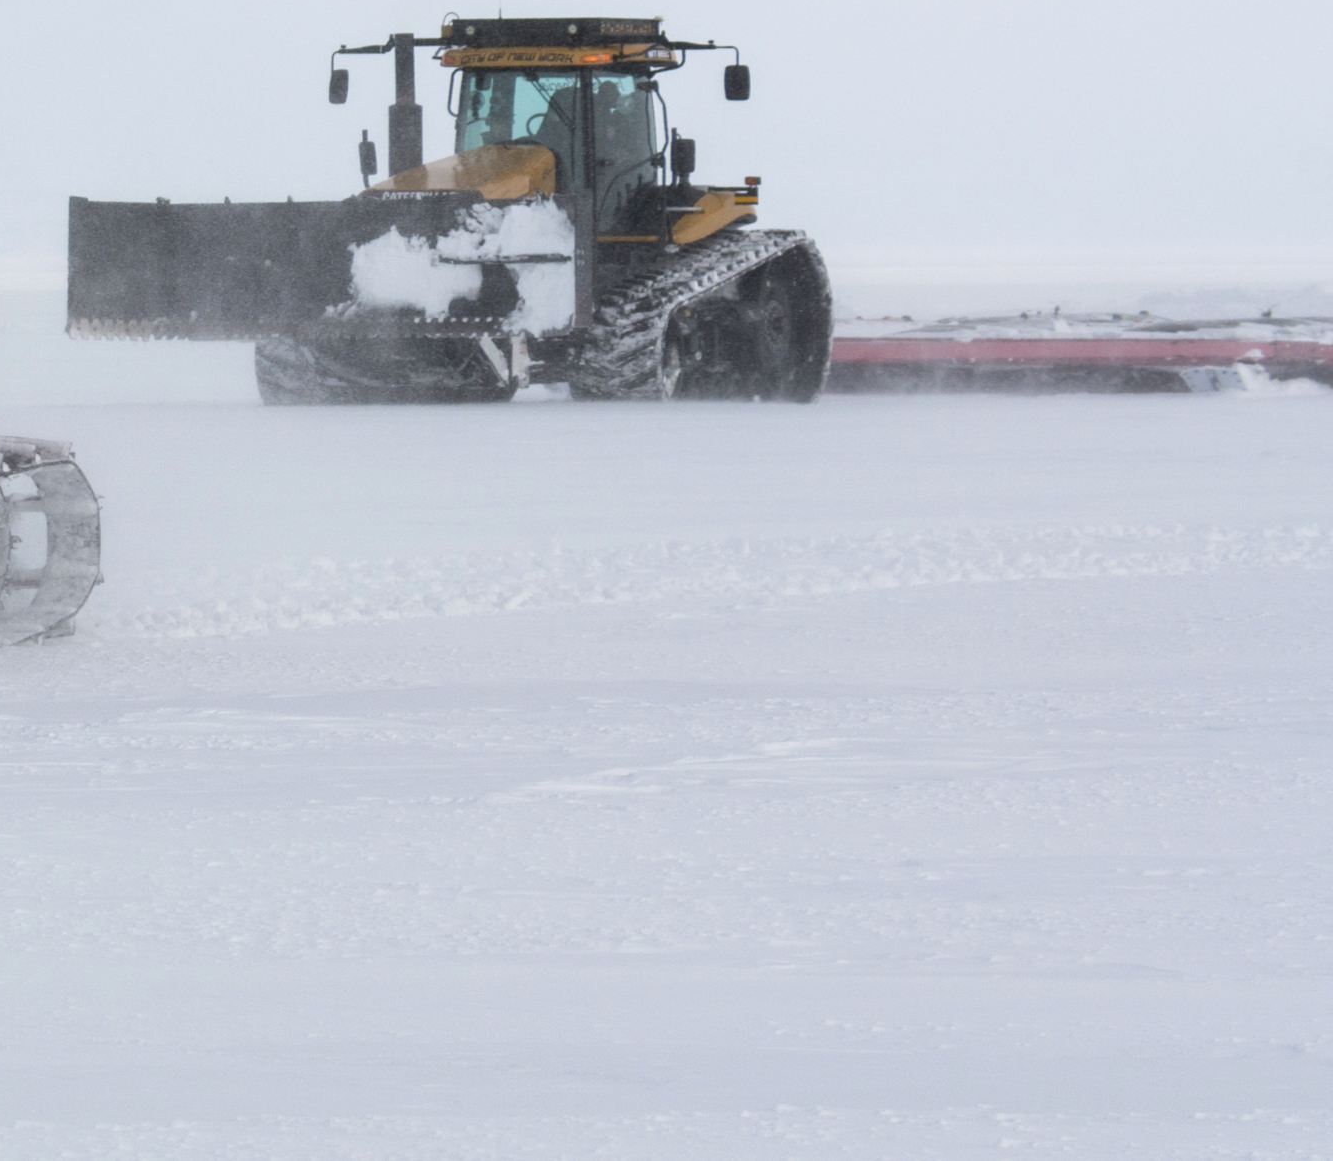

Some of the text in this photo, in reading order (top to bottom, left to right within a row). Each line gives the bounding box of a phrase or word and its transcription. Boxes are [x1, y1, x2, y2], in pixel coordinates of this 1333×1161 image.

[460, 54, 485, 65] CITY
[487, 52, 506, 62] OF
[538, 52, 575, 63] YORK
